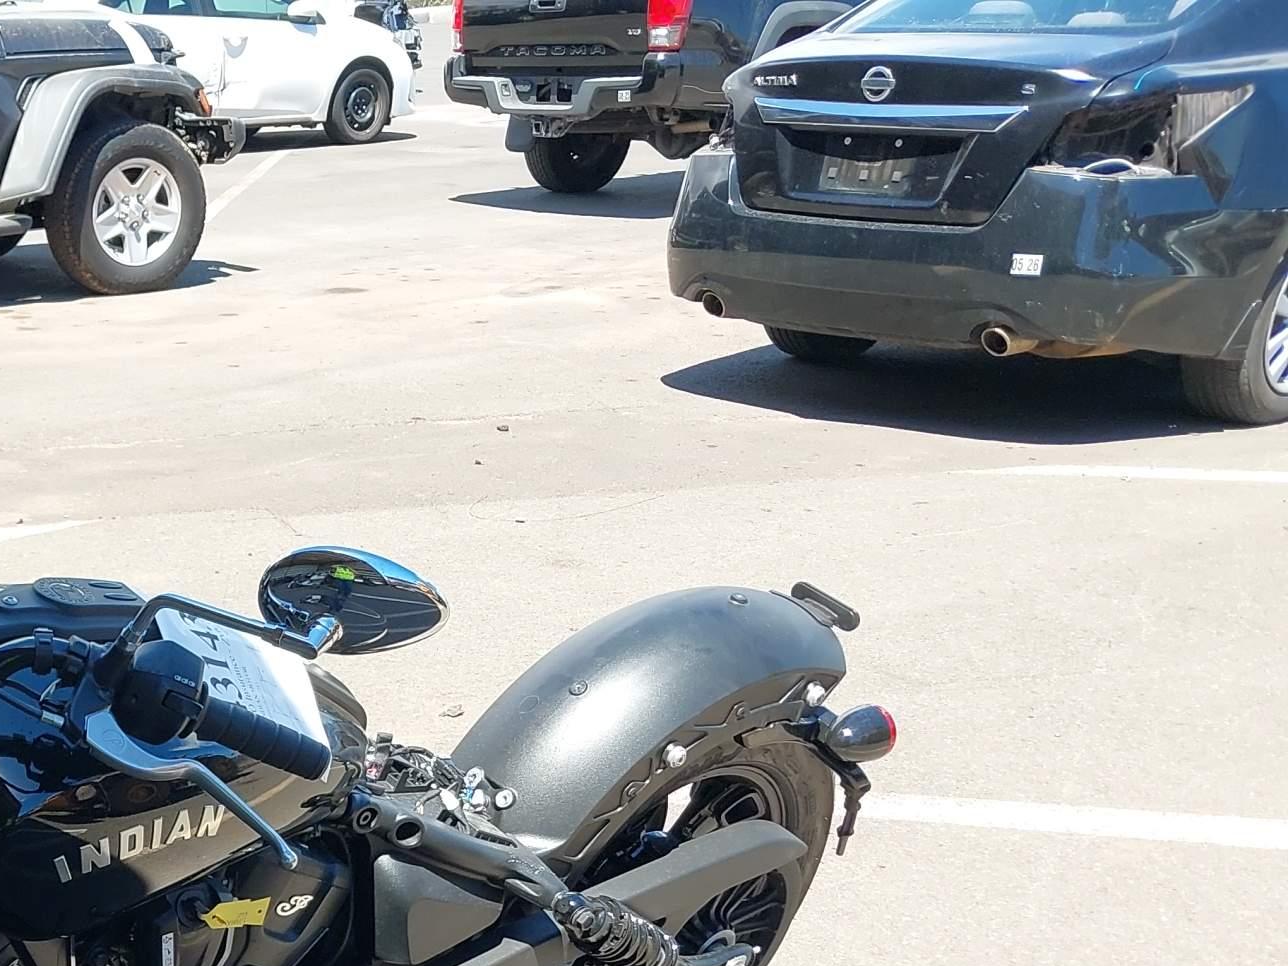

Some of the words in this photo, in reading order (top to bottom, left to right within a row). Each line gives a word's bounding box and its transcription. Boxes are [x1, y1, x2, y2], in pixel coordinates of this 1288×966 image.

[499, 45, 606, 56] TACOMA
[1020, 83, 1036, 95] S
[1026, 258, 1040, 272] 26
[53, 804, 226, 884] INDIAN
